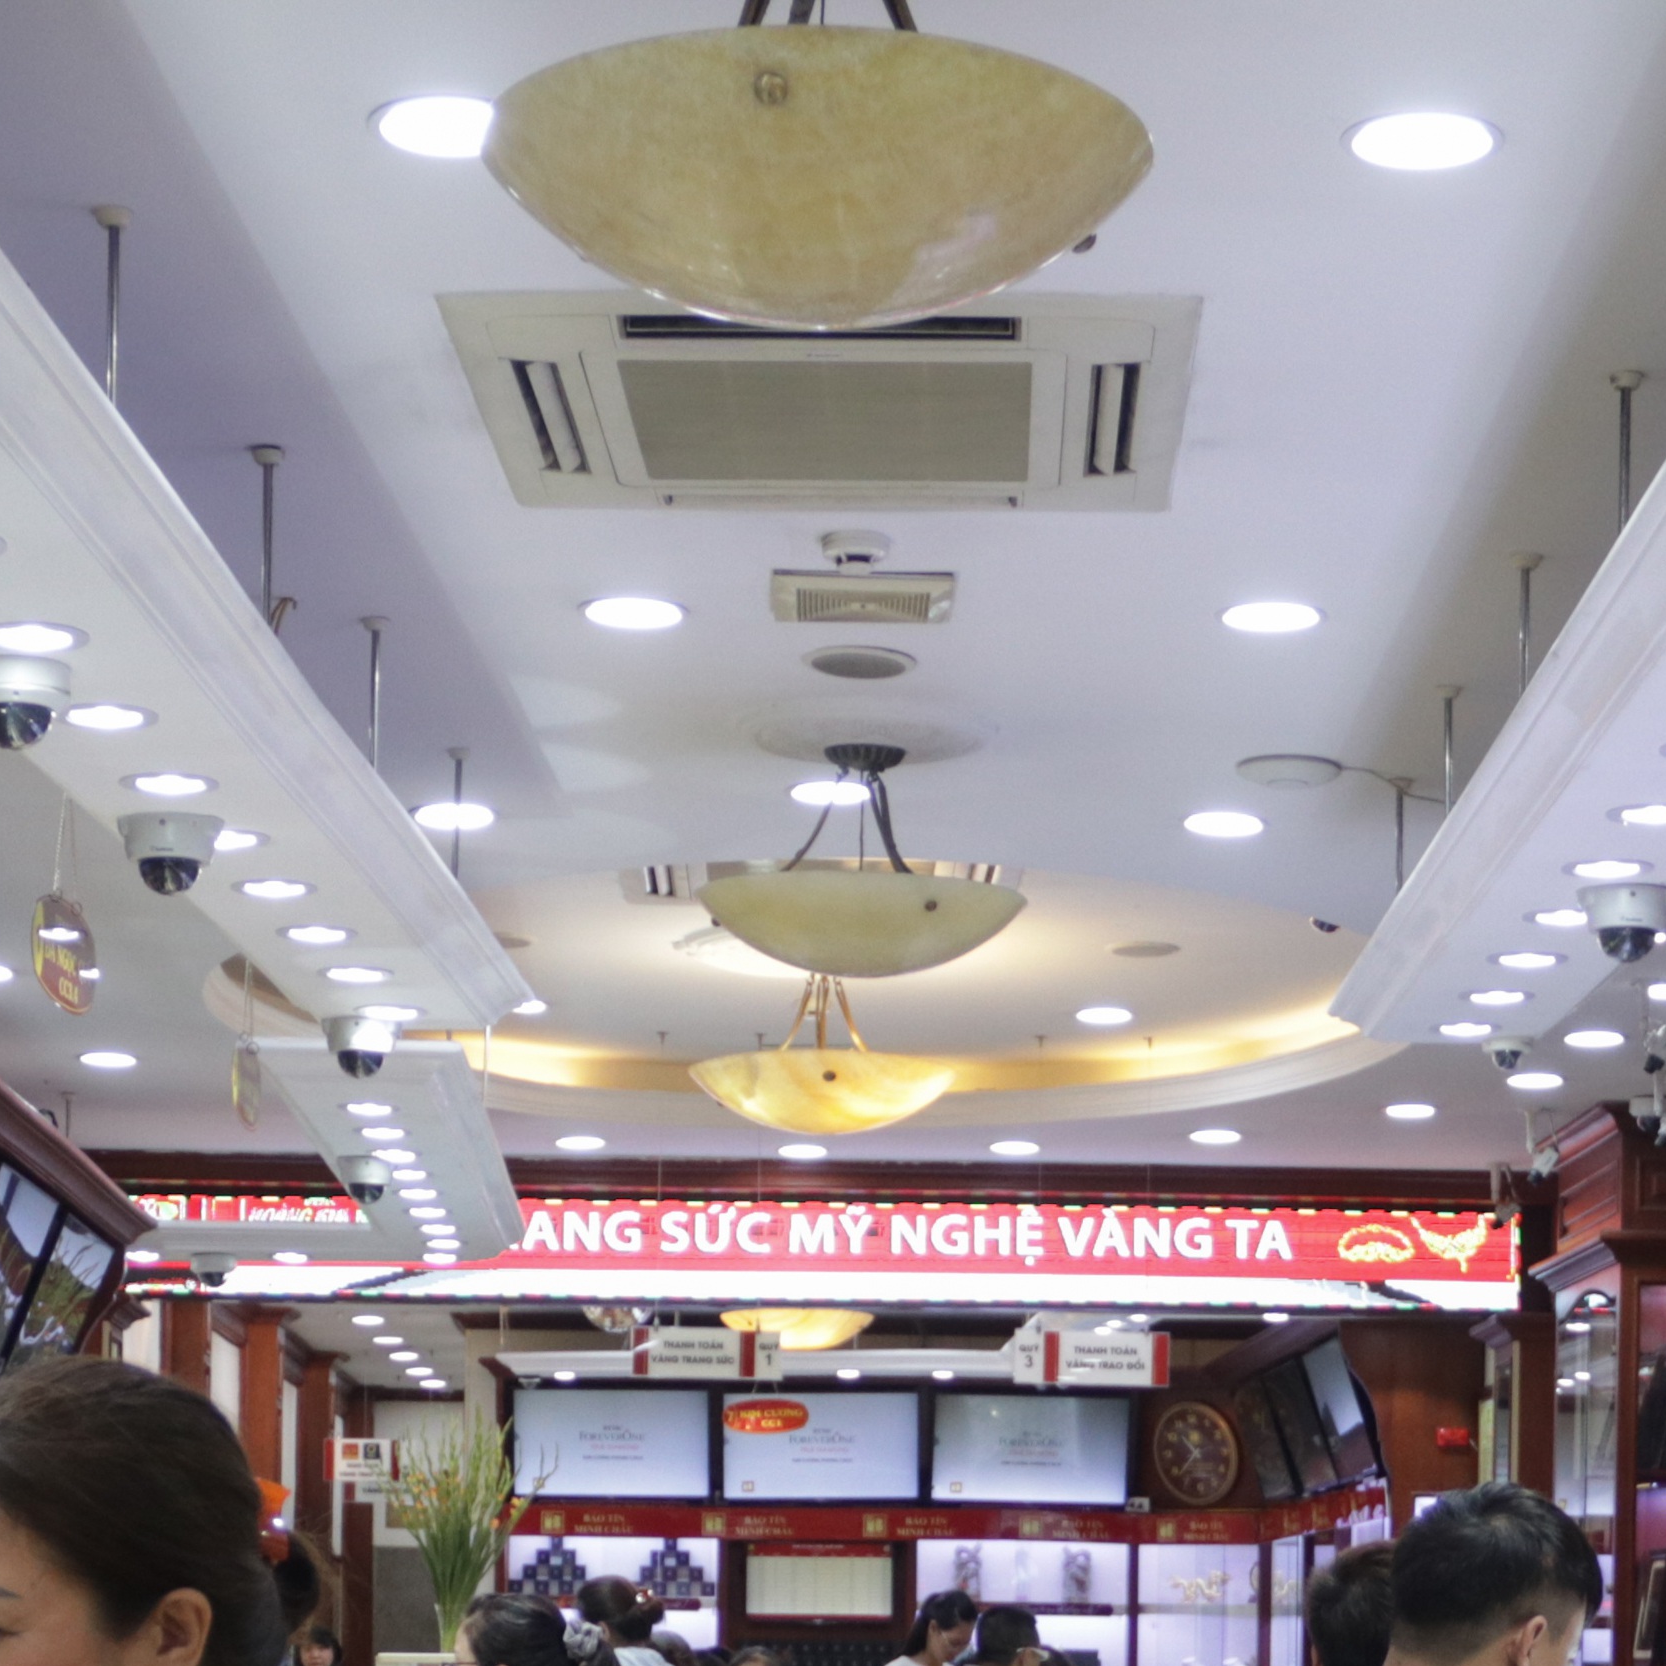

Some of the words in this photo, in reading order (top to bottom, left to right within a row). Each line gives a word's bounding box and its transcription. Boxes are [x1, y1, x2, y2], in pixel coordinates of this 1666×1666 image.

[509, 1209, 642, 1253] ANG
[659, 1203, 773, 1255] SỨC
[788, 1204, 874, 1255] MỸ
[889, 1204, 1045, 1266] NGHỆ
[1056, 1207, 1215, 1259] VÀNG
[1225, 1217, 1294, 1261] TA
[663, 1340, 695, 1350] THANH
[697, 1338, 724, 1350] TOÁN
[1074, 1345, 1107, 1355] THANH
[1110, 1344, 1137, 1356] TOÁN
[651, 1353, 679, 1364] VÀNG
[682, 1355, 713, 1364] TRANG
[716, 1354, 735, 1365] SỨC
[766, 1353, 773, 1366] 1
[1024, 1354, 1033, 1368] 3
[1098, 1361, 1124, 1370] TRAO
[1125, 1357, 1146, 1371] ĐỔI
